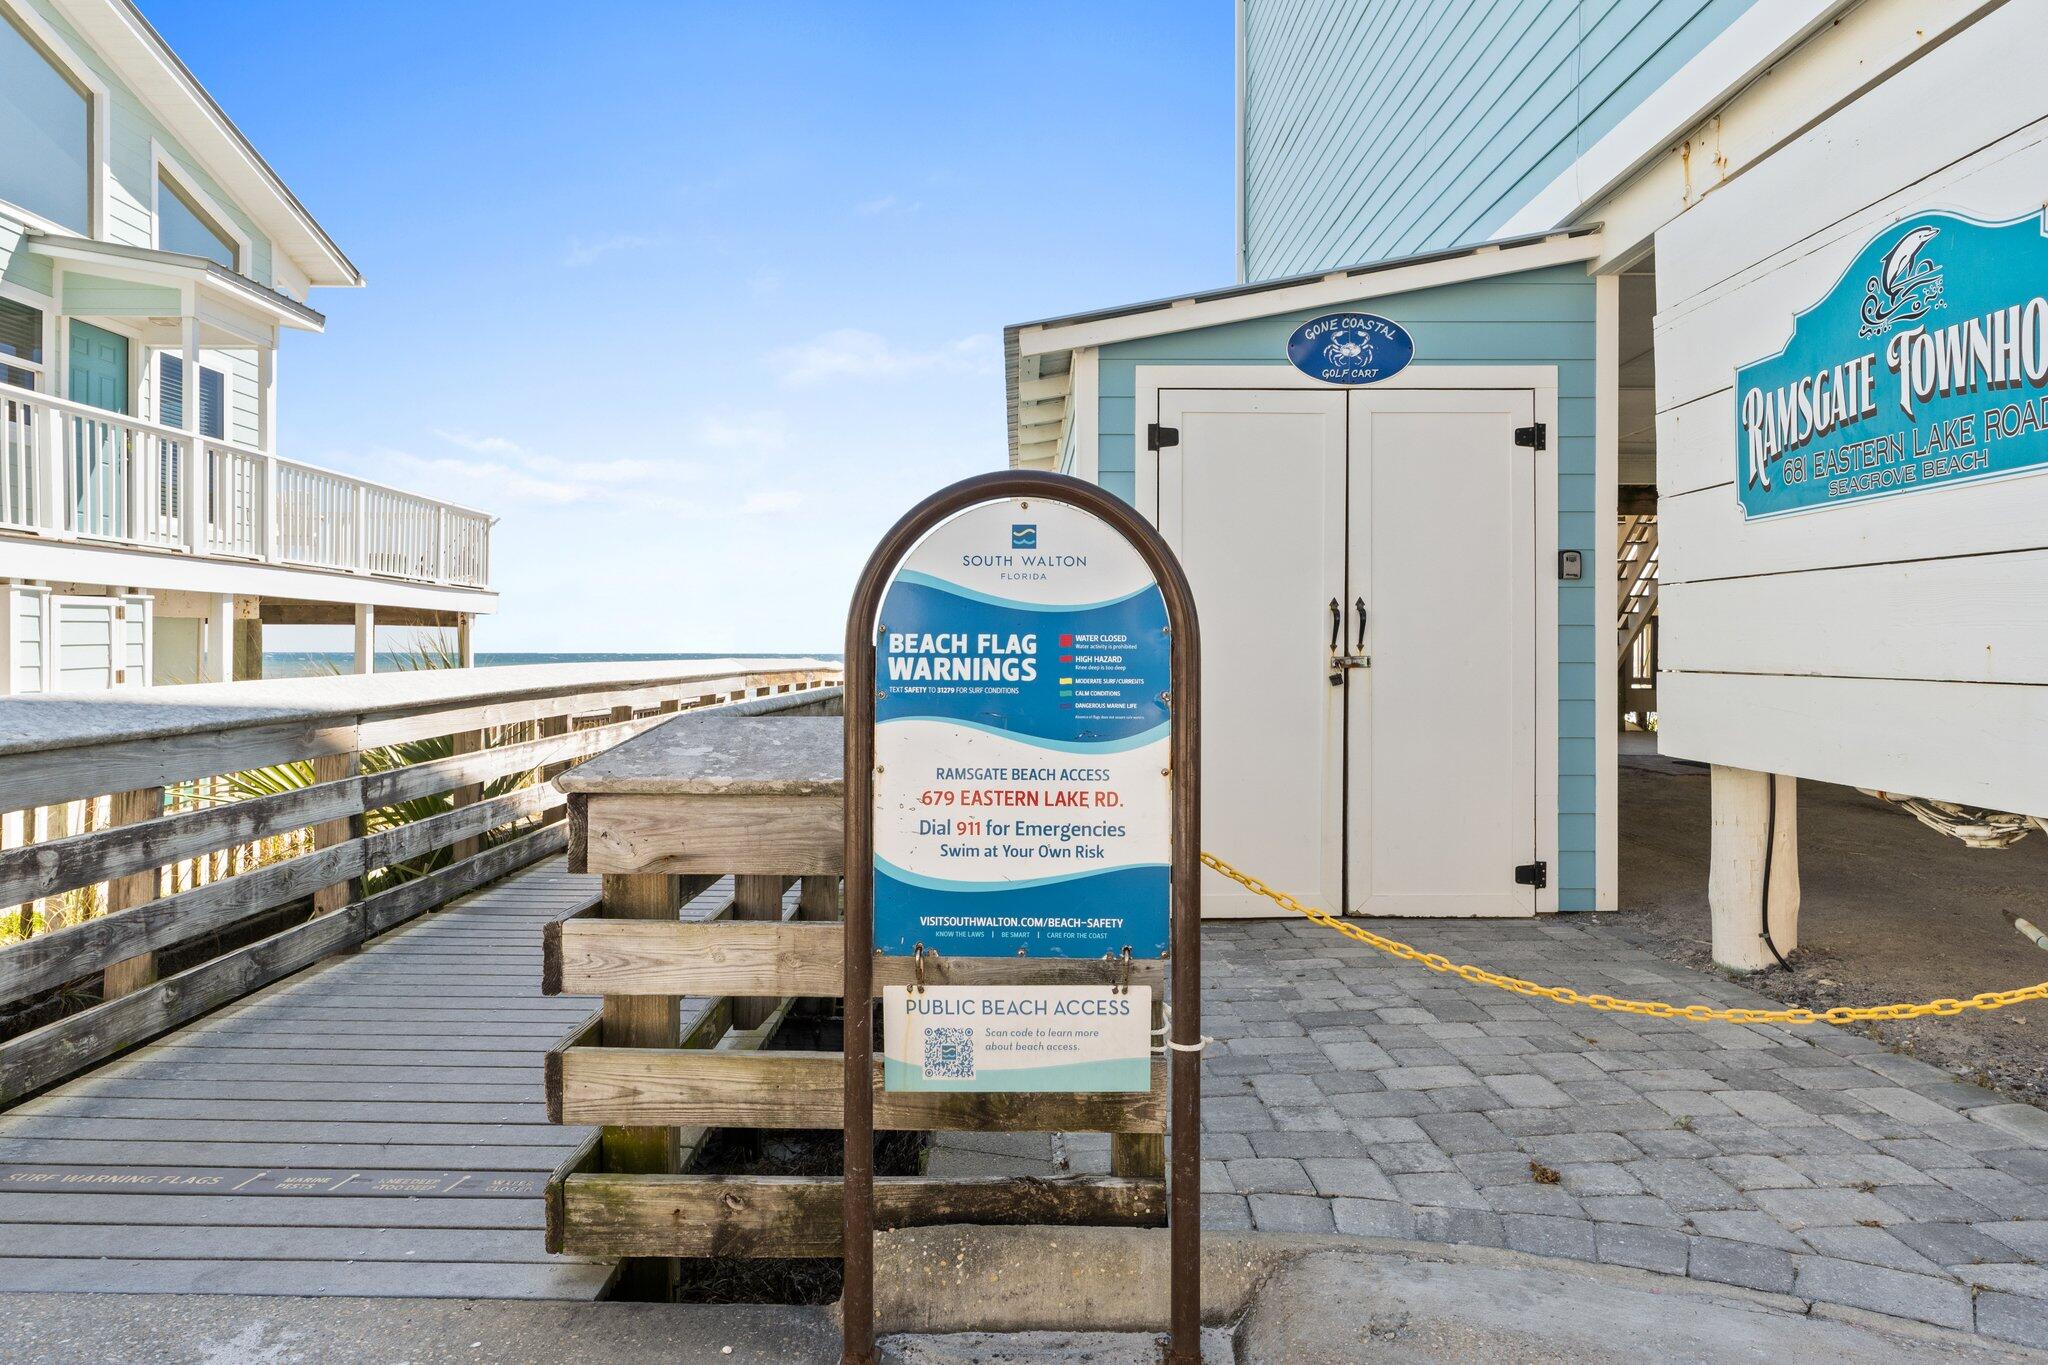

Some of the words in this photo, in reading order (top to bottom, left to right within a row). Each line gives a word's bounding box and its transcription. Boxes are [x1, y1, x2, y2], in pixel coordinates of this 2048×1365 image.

[1305, 319, 1338, 340] GONE
[1342, 318, 1397, 340] COASTAL
[1322, 369, 1350, 379] GOLF
[1351, 369, 1379, 378] CART
[1742, 353, 1877, 492] RAMSGATE
[1783, 455, 1807, 484] 681
[1814, 432, 1904, 477] EASTERN
[1912, 415, 1975, 457] LAKE
[1829, 465, 1915, 496] SEAGROVE
[1923, 450, 1988, 478] BEACH
[962, 555, 1013, 566] SOUTH
[1021, 556, 1087, 567] WALTON
[889, 633, 968, 654] BEACH
[977, 633, 1037, 654] FLAG
[1075, 634, 1099, 642] WATER
[1100, 634, 1127, 642] CLOSED
[1075, 655, 1092, 663] HIGH
[1094, 655, 1122, 663] HAZARD
[887, 656, 1037, 681] WARNINGS
[936, 767, 1008, 781] RAMSGATE
[1011, 768, 1056, 781] BEACH
[1060, 769, 1110, 781] ACCESS
[922, 790, 955, 806] 679
[960, 790, 1039, 807] EASTERN
[1044, 791, 1089, 807] LAKE
[1094, 791, 1124, 807] RD.
[920, 819, 951, 835] Dial
[957, 821, 981, 836] 911
[986, 819, 1010, 836] for
[1015, 820, 1126, 841] Emergencies
[940, 844, 980, 857] Swim
[984, 846, 998, 857] at
[1002, 845, 1034, 858] Your
[1038, 845, 1071, 858] Own
[1075, 845, 1104, 859] Risk
[920, 916, 1123, 929] VISITSOUTHWALTON.COM/BEACH-SAFETY
[1010, 931, 1030, 939] SMART
[906, 999, 976, 1015] PUBLIC
[982, 999, 1047, 1015] BEACH
[1054, 1000, 1130, 1016] ACCESS
[985, 1028, 1009, 1037] Scan
[1010, 1028, 1034, 1037] code
[1036, 1028, 1046, 1037] to
[1048, 1028, 1073, 1037] learn
[985, 1042, 1014, 1051] about
[1016, 1042, 1044, 1051] beach
[3, 1173, 60, 1183] SURF
[60, 1174, 158, 1184] WARNING
[158, 1175, 224, 1185] FLAGS
